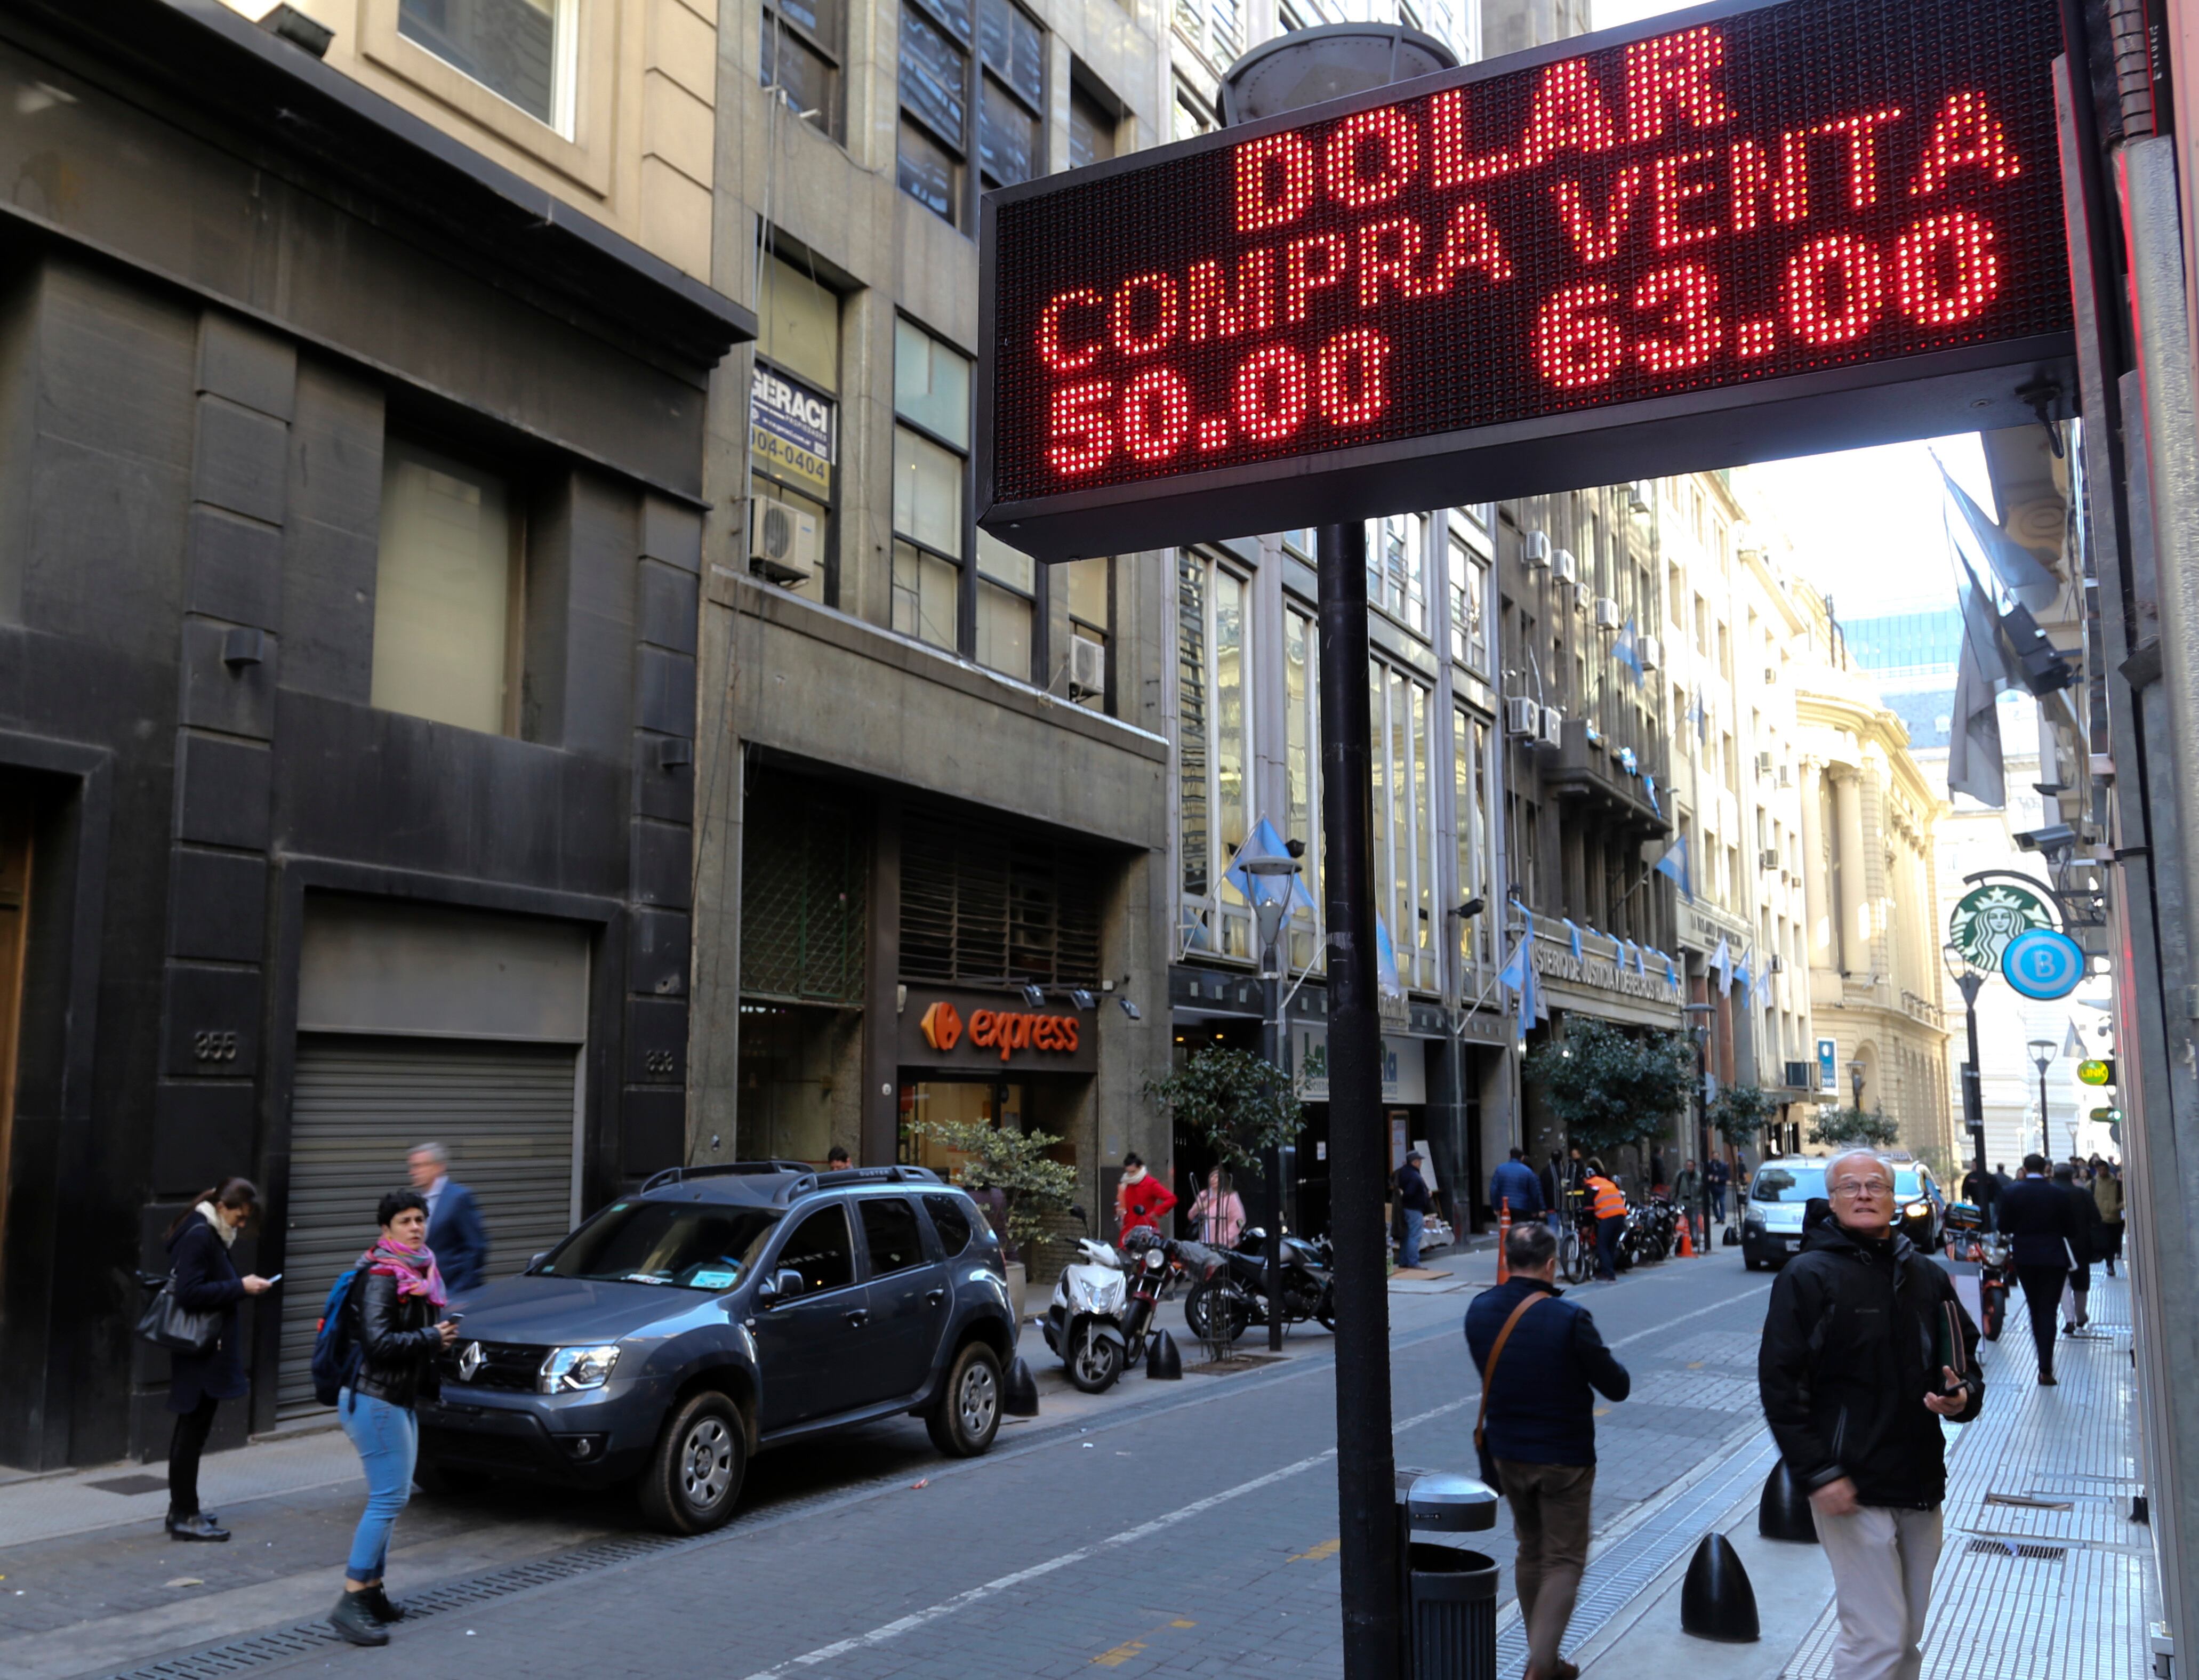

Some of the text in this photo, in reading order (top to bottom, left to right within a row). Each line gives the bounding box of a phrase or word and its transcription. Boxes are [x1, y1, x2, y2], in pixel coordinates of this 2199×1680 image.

[1235, 26, 1736, 232] DOLAR
[1039, 91, 2021, 371] COMPRA VENTA
[1049, 211, 1997, 476] 50.00 63.00
[752, 368, 827, 432] GERACI
[751, 428, 825, 479] 04-0404
[968, 1008, 1080, 1061] express
[2081, 1065, 2106, 1077] LINK
